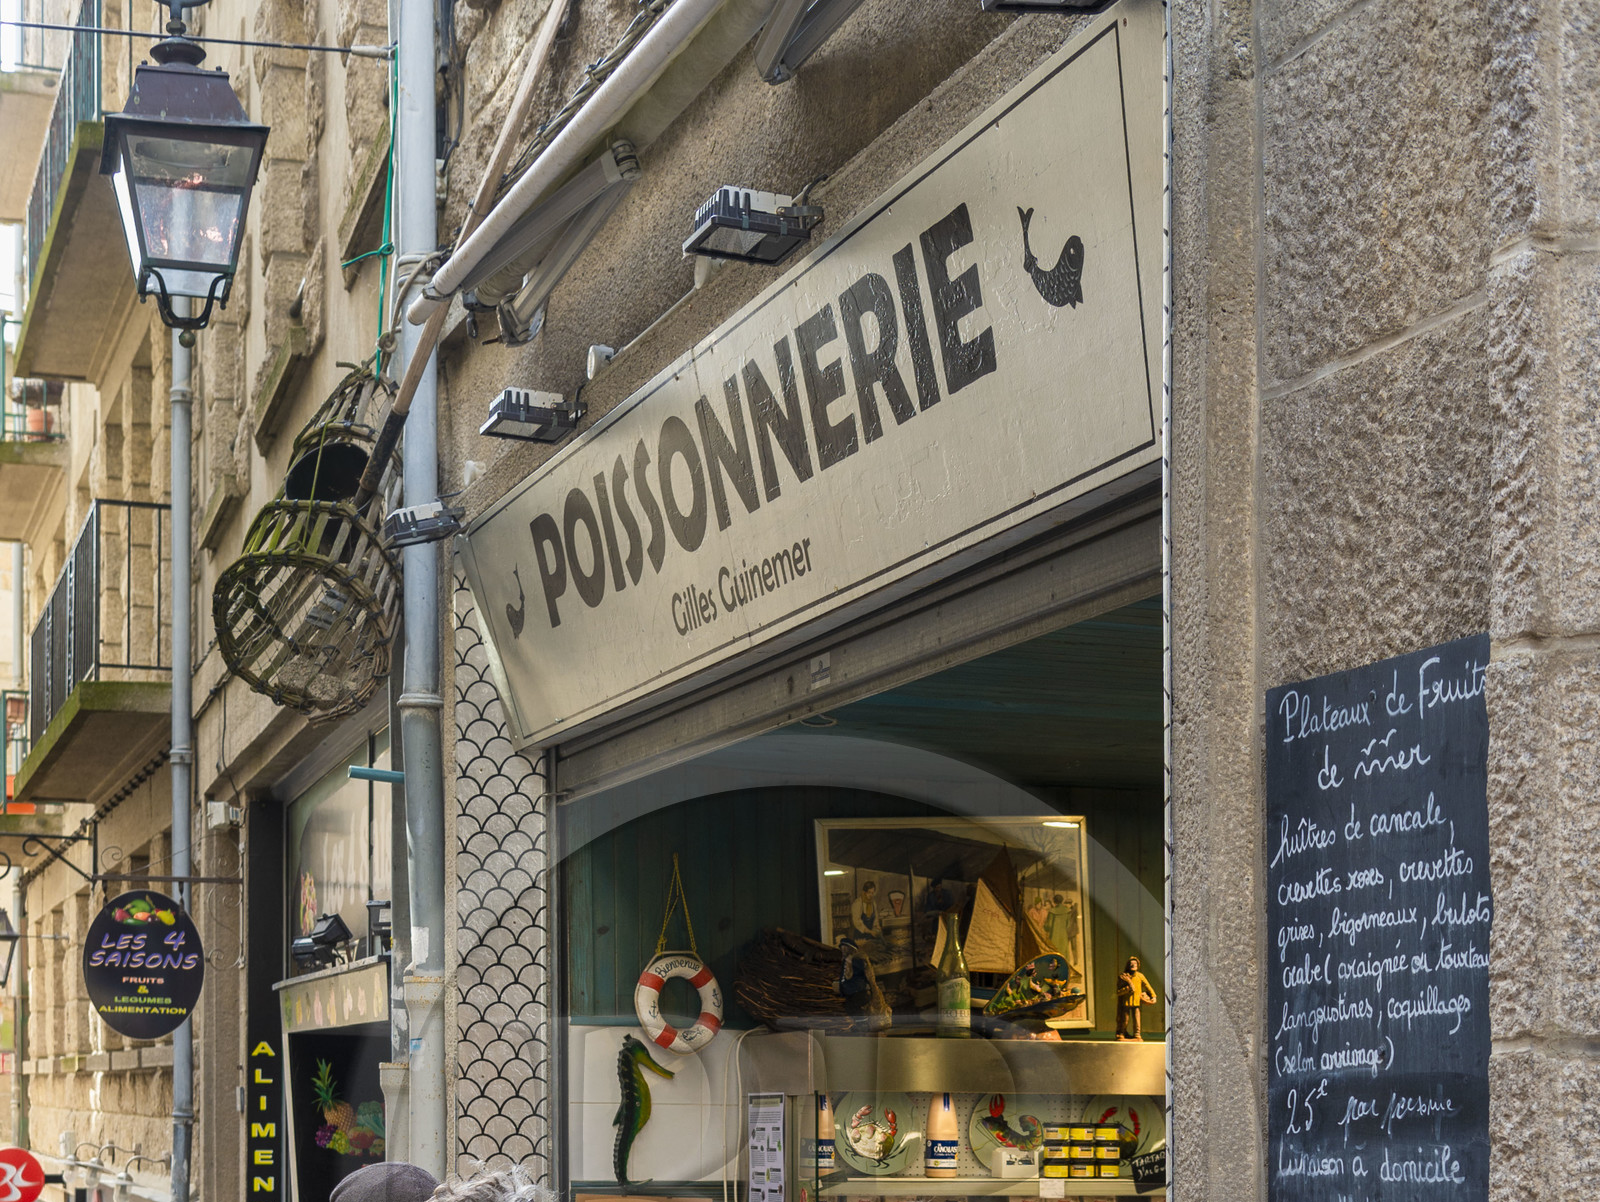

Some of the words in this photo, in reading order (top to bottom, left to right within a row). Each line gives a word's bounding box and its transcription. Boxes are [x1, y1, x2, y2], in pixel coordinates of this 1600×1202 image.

[530, 202, 997, 628] POISSONNERIE
[671, 583, 717, 636] Gilles
[718, 537, 812, 613] Guinemer
[1279, 689, 1370, 743] Plateaux
[1385, 669, 1413, 716] de
[1318, 745, 1344, 790] de
[1270, 813, 1336, 870] huîtres
[1344, 803, 1364, 840] de
[1278, 868, 1343, 906] crevettes
[1399, 846, 1473, 883] crevettes
[101, 932, 148, 951] LES
[163, 930, 187, 952] 4
[89, 949, 199, 971] SAISONS
[654, 959, 700, 979] Bienvenue
[1411, 951, 1432, 974] ou
[122, 976, 165, 985] FRUITS
[137, 985, 149, 994] &
[99, 1005, 187, 1015] ALIMENTATION
[114, 996, 172, 1005] LEGUMES
[1387, 985, 1471, 1035] coquillages
[1380, 1145, 1465, 1184] domicile
